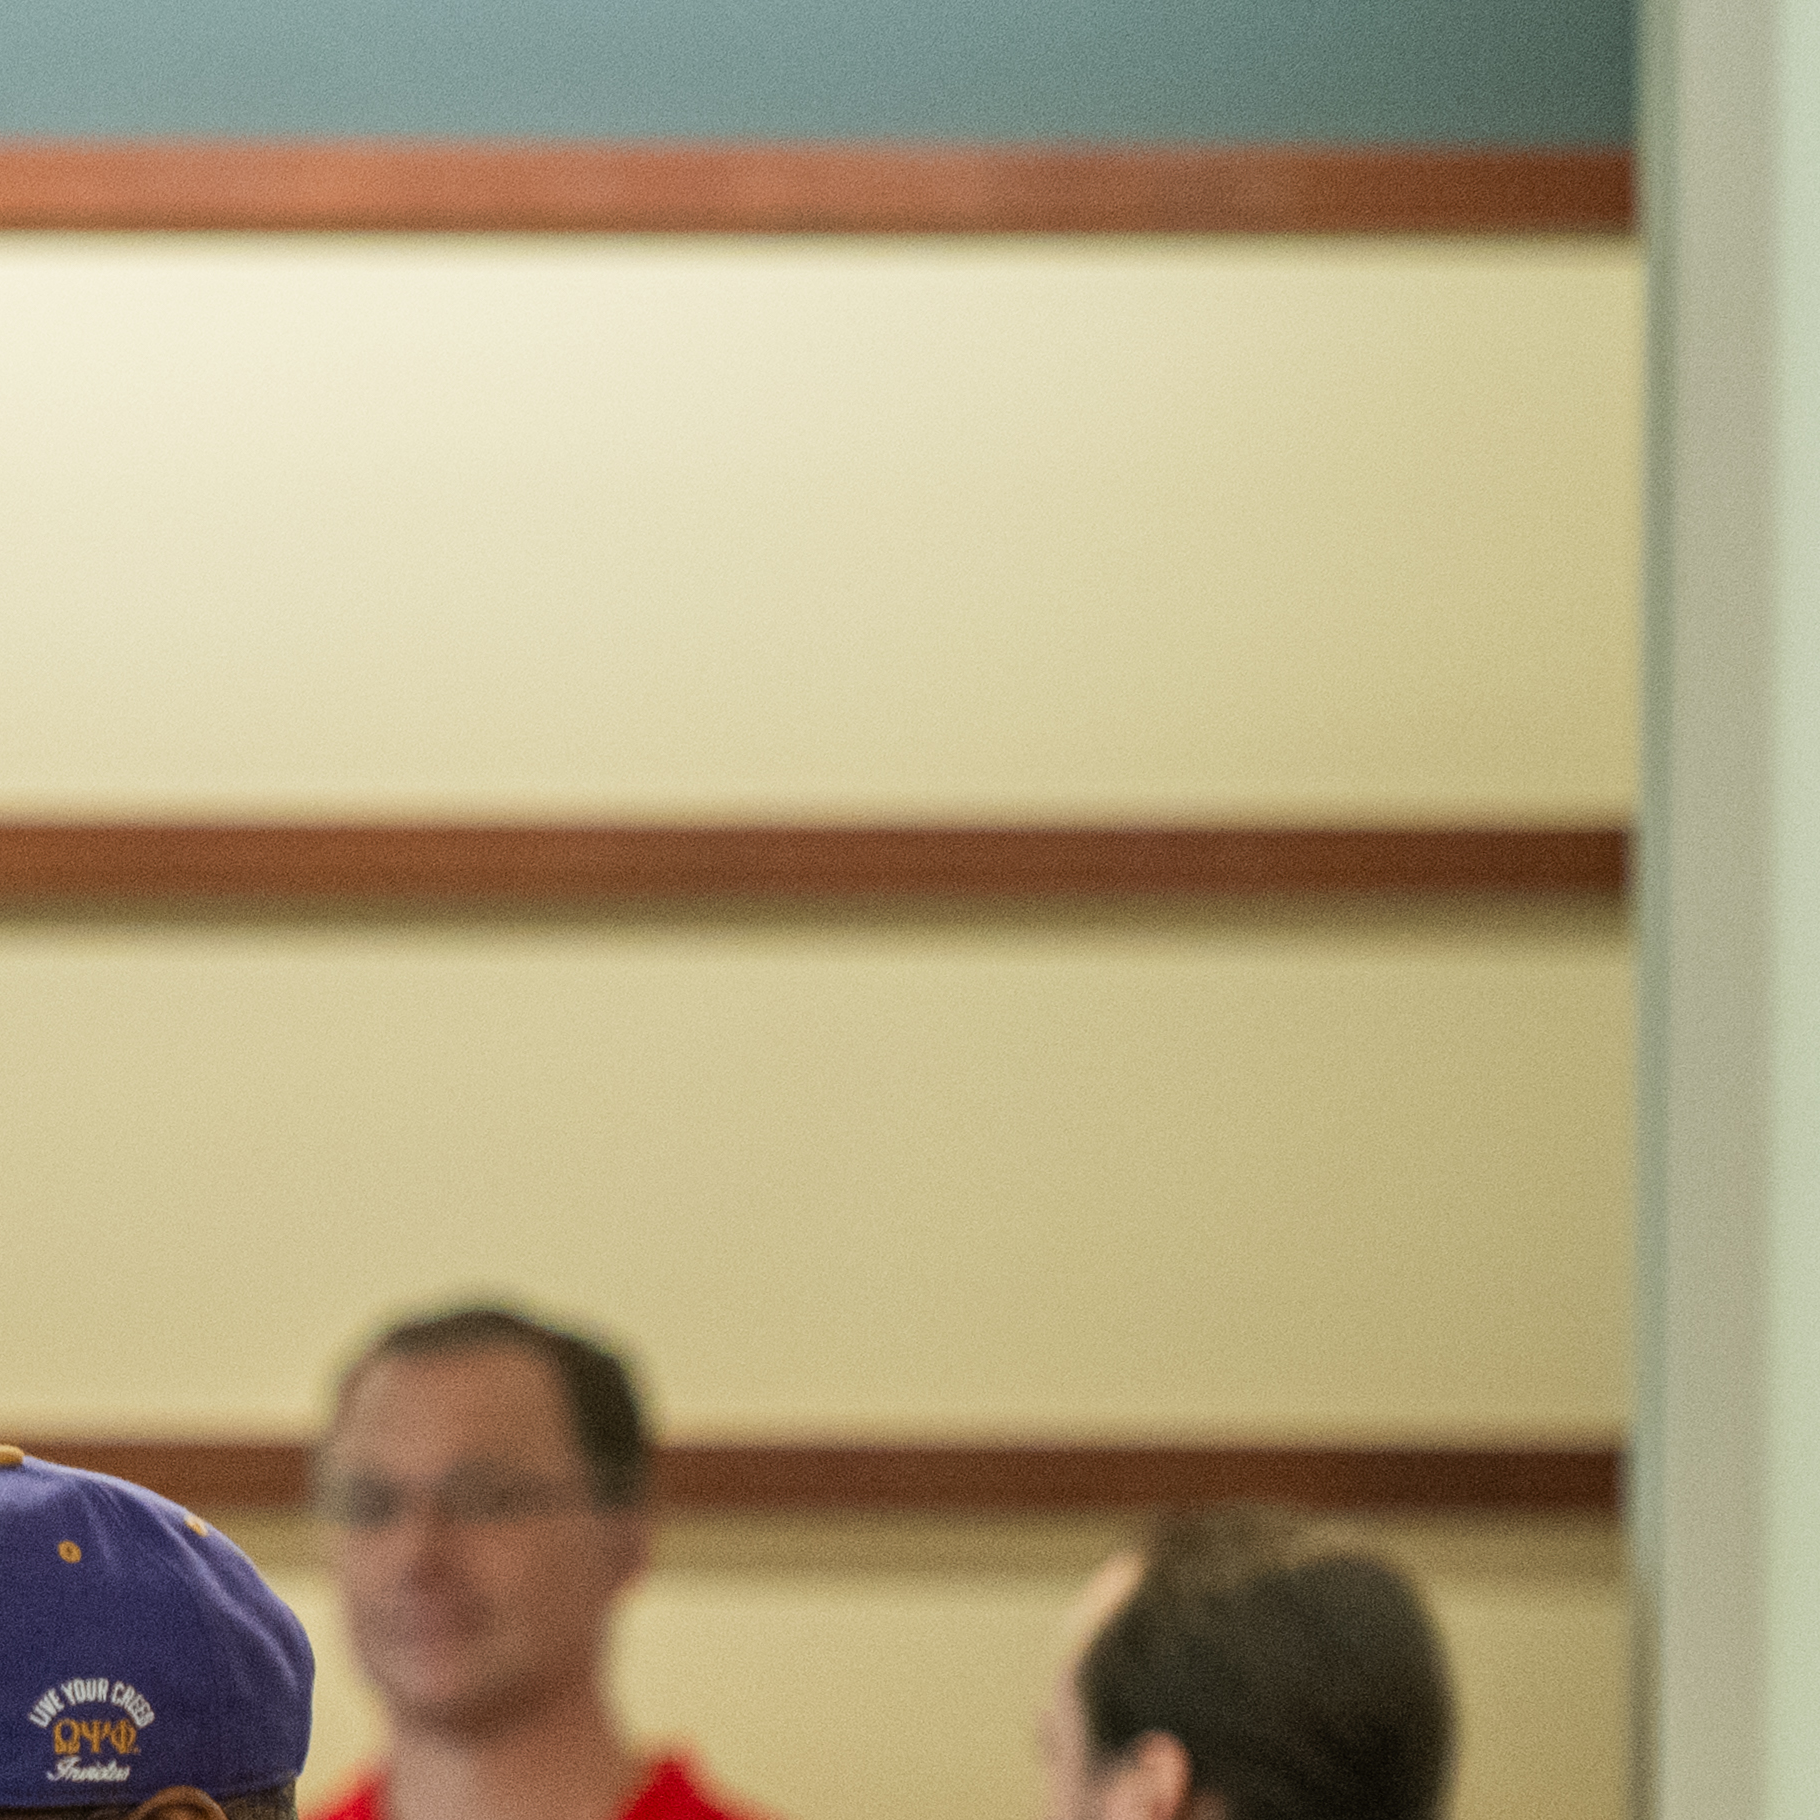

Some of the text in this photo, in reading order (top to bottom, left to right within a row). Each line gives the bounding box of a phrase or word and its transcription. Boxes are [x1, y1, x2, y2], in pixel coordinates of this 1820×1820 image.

[28, 1677, 155, 1729] LIVE YOUR CREED
